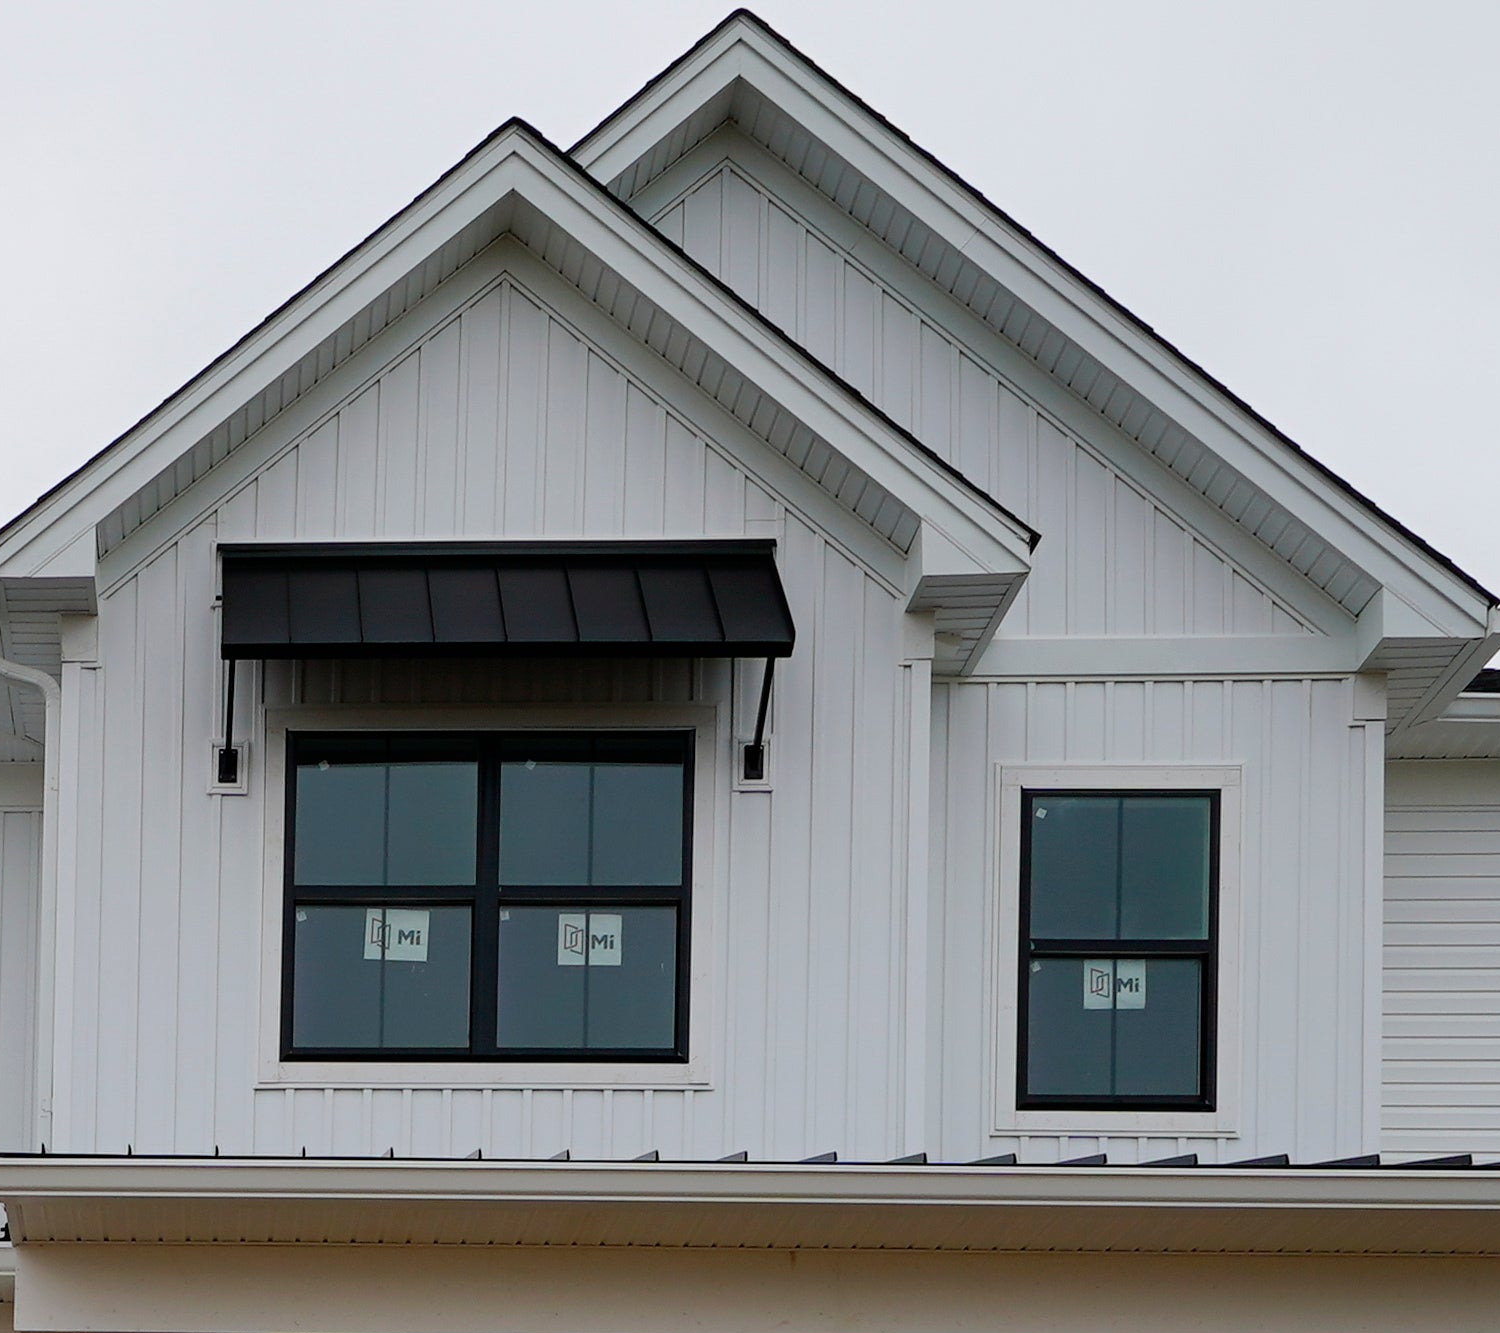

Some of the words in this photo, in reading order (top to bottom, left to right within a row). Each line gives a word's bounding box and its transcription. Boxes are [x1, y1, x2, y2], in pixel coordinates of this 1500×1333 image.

[397, 929, 422, 947] Mi
[590, 933, 615, 951] Mi
[1117, 977, 1140, 994] Mi
